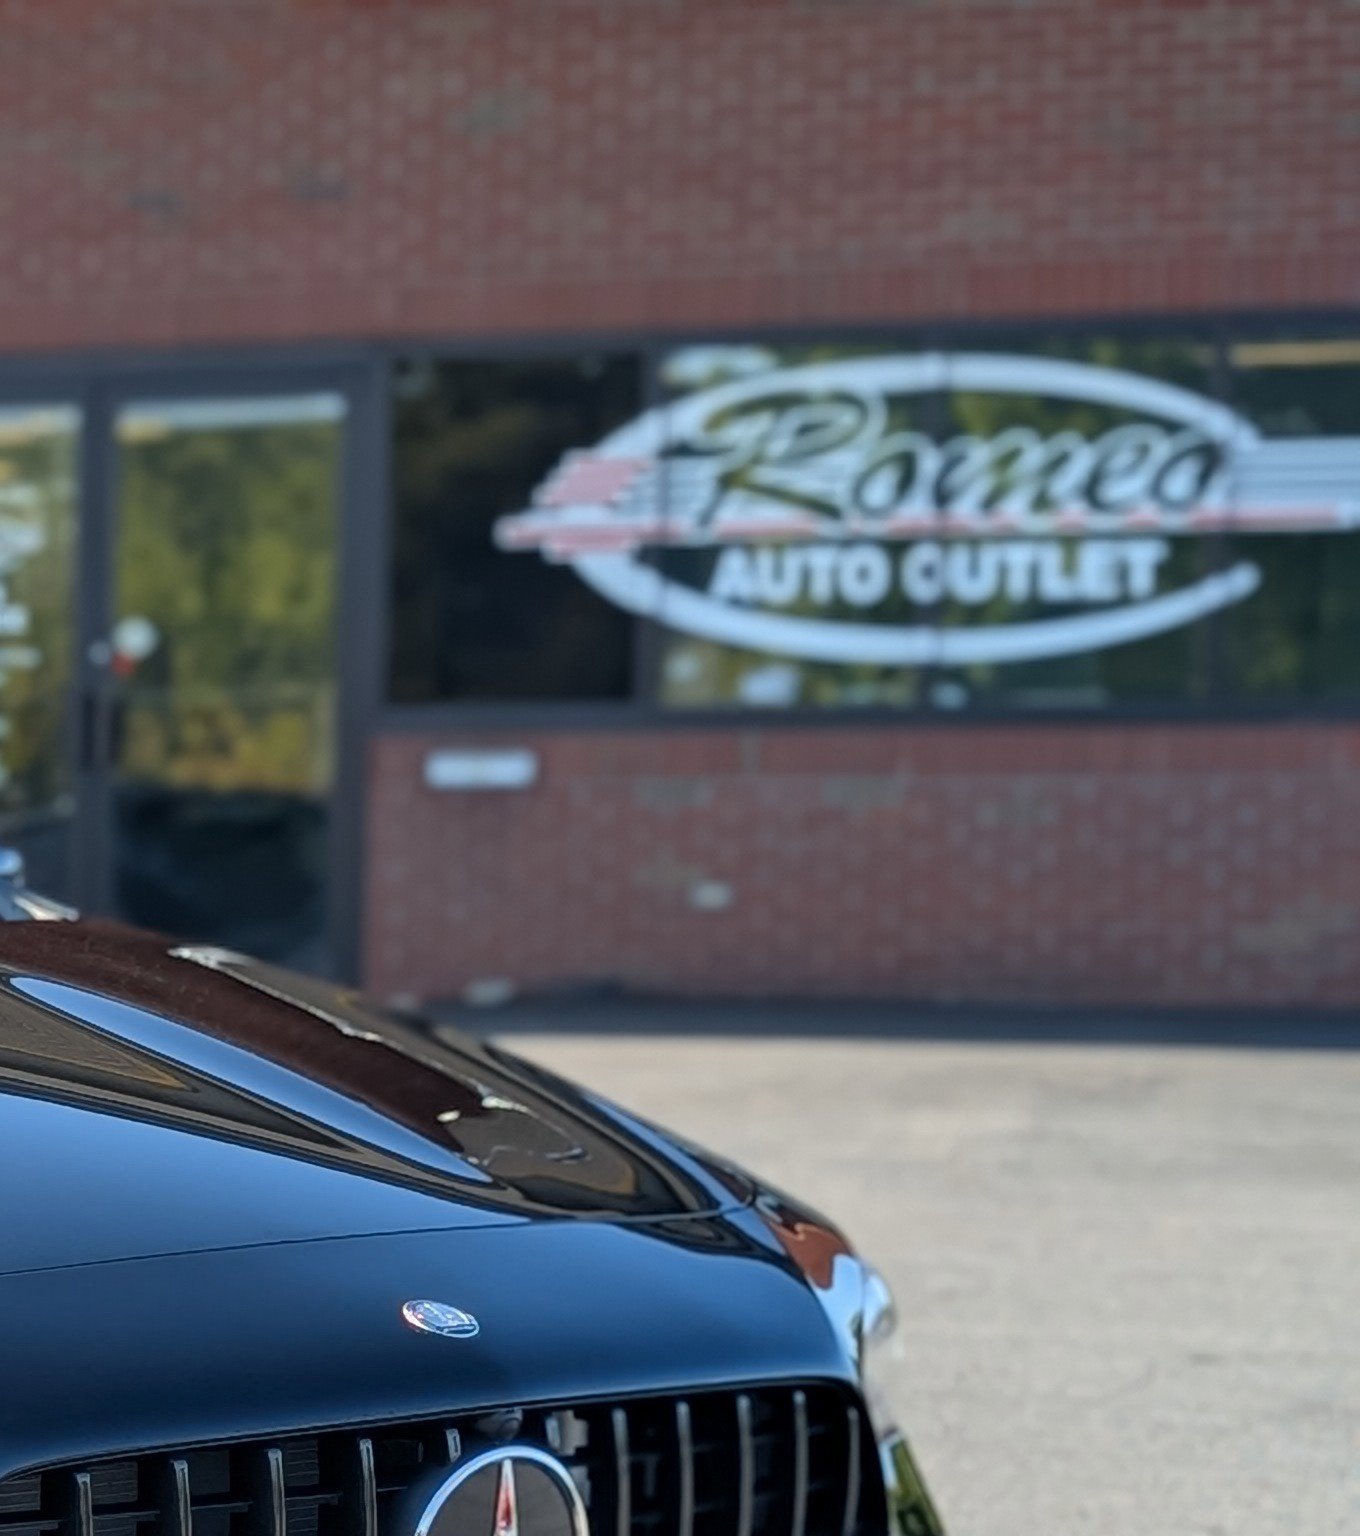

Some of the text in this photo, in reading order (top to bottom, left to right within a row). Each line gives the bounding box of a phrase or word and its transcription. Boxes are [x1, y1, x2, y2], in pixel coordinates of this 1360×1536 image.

[700, 390, 1228, 527] Romeo
[711, 539, 1168, 606] AUTO OUTLET
